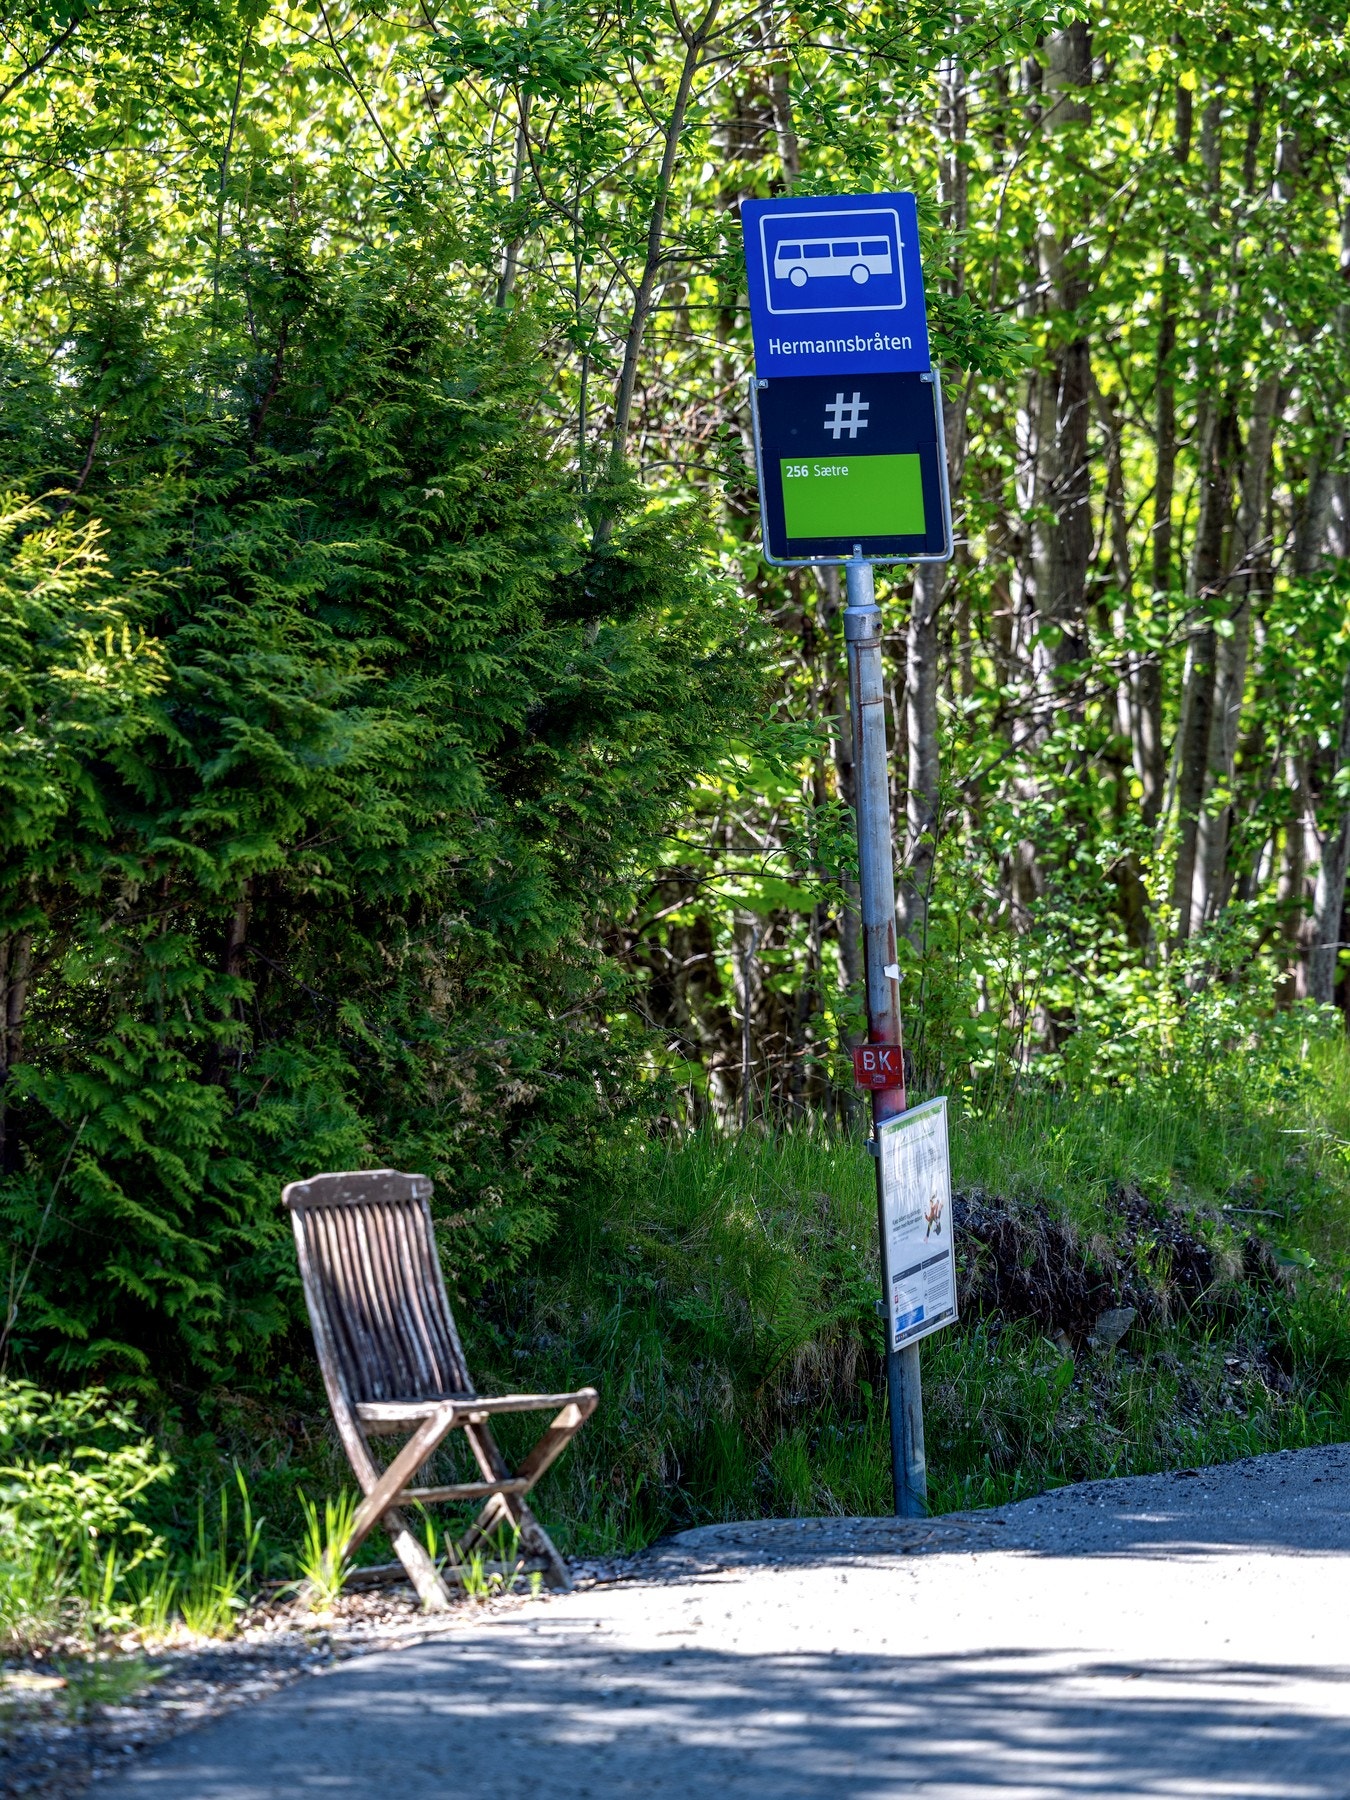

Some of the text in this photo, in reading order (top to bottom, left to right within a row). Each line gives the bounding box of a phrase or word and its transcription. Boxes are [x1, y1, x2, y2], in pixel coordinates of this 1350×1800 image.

[768, 332, 913, 355] Hermannsbråten
[785, 464, 849, 478] 256 Sætre
[862, 1050, 893, 1072] BK
